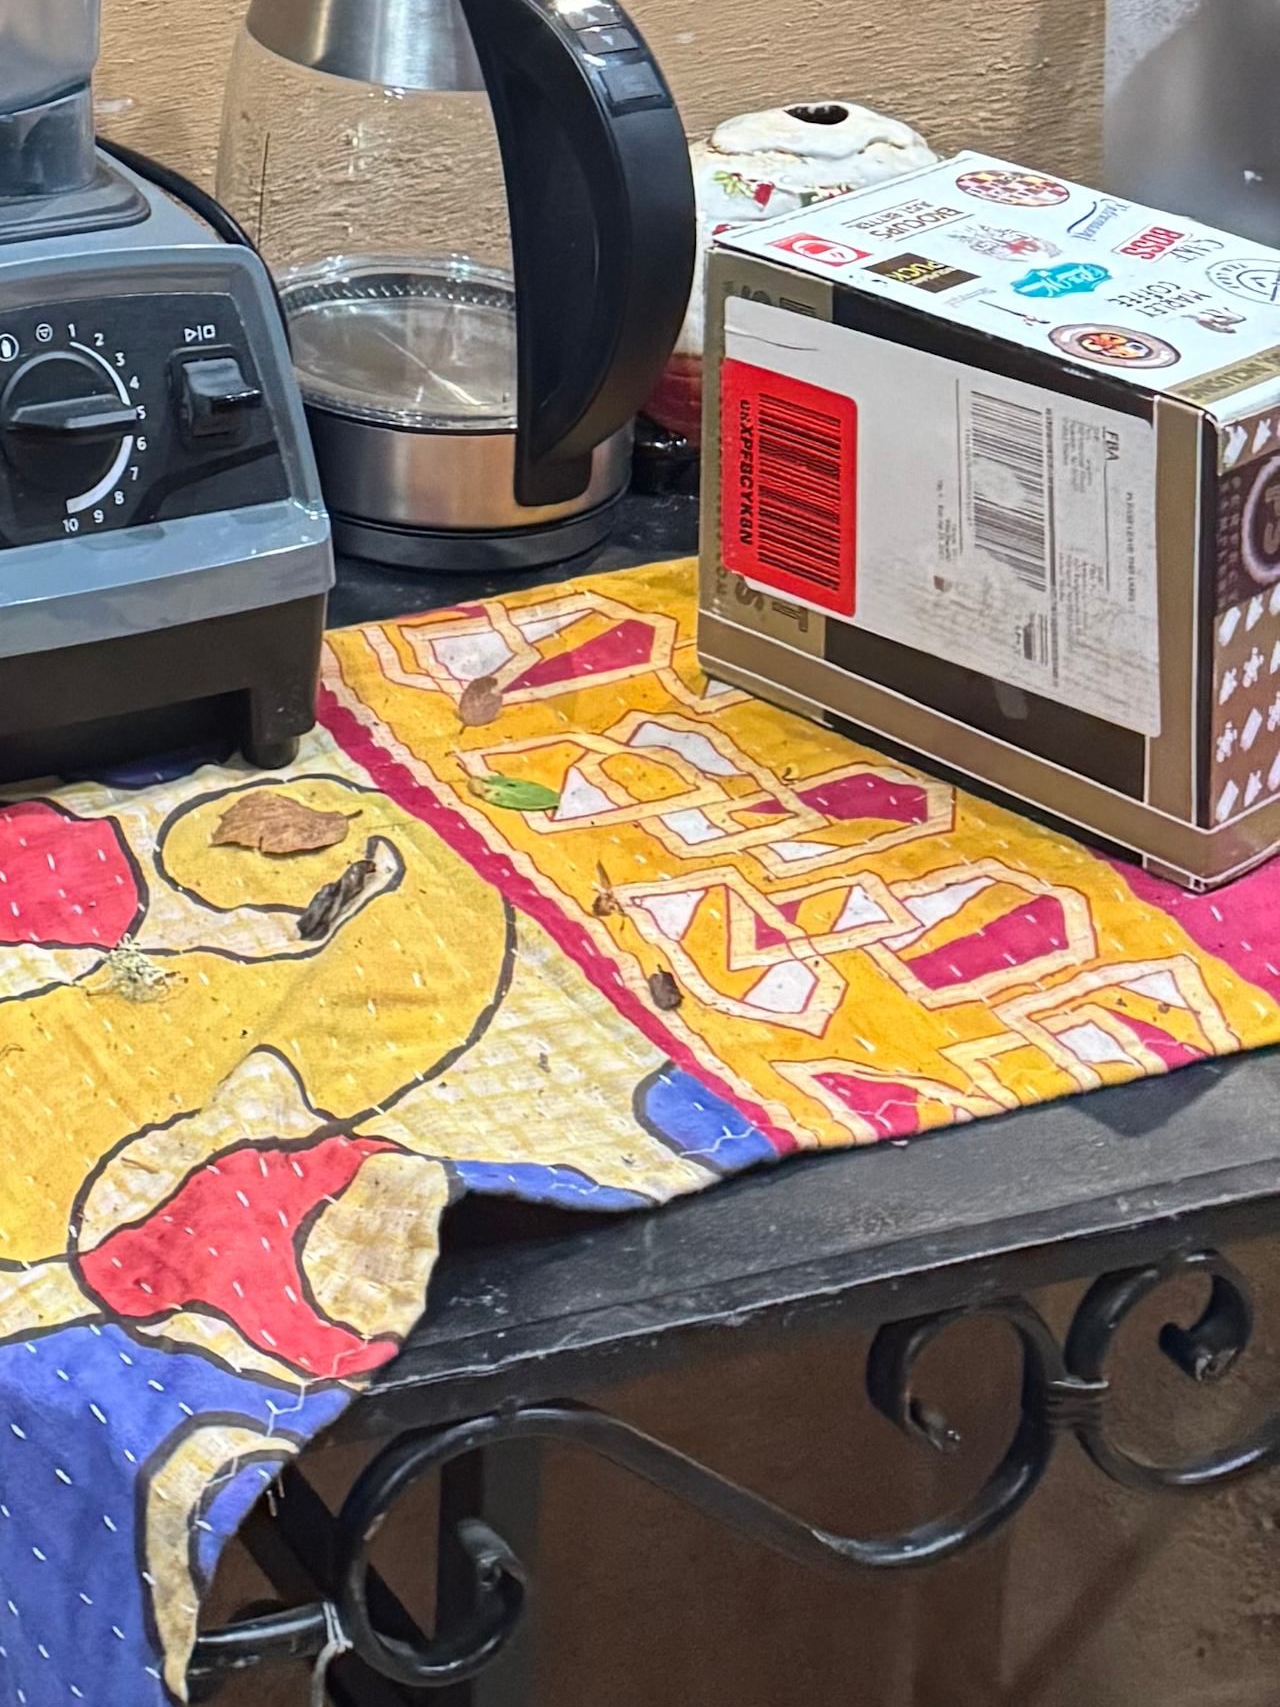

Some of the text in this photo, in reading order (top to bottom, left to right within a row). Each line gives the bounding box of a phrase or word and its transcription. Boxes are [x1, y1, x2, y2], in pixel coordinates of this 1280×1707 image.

[869, 206, 965, 240] EKOCUPS
[1120, 226, 1185, 260] BOSS
[886, 258, 945, 282] PUCK
[1106, 281, 1181, 307] COFFEE
[1136, 289, 1212, 318] MARLEY
[68, 323, 76, 337] 1
[94, 333, 104, 347] 2
[115, 352, 125, 366] 3
[129, 375, 140, 390] 4
[136, 405, 146, 420] 5
[136, 437, 147, 451] 6
[1105, 428, 1120, 461] FBA
[130, 467, 139, 481] 7
[114, 491, 124, 505] 8
[93, 510, 104, 524] 9
[62, 518, 79, 533] 10
